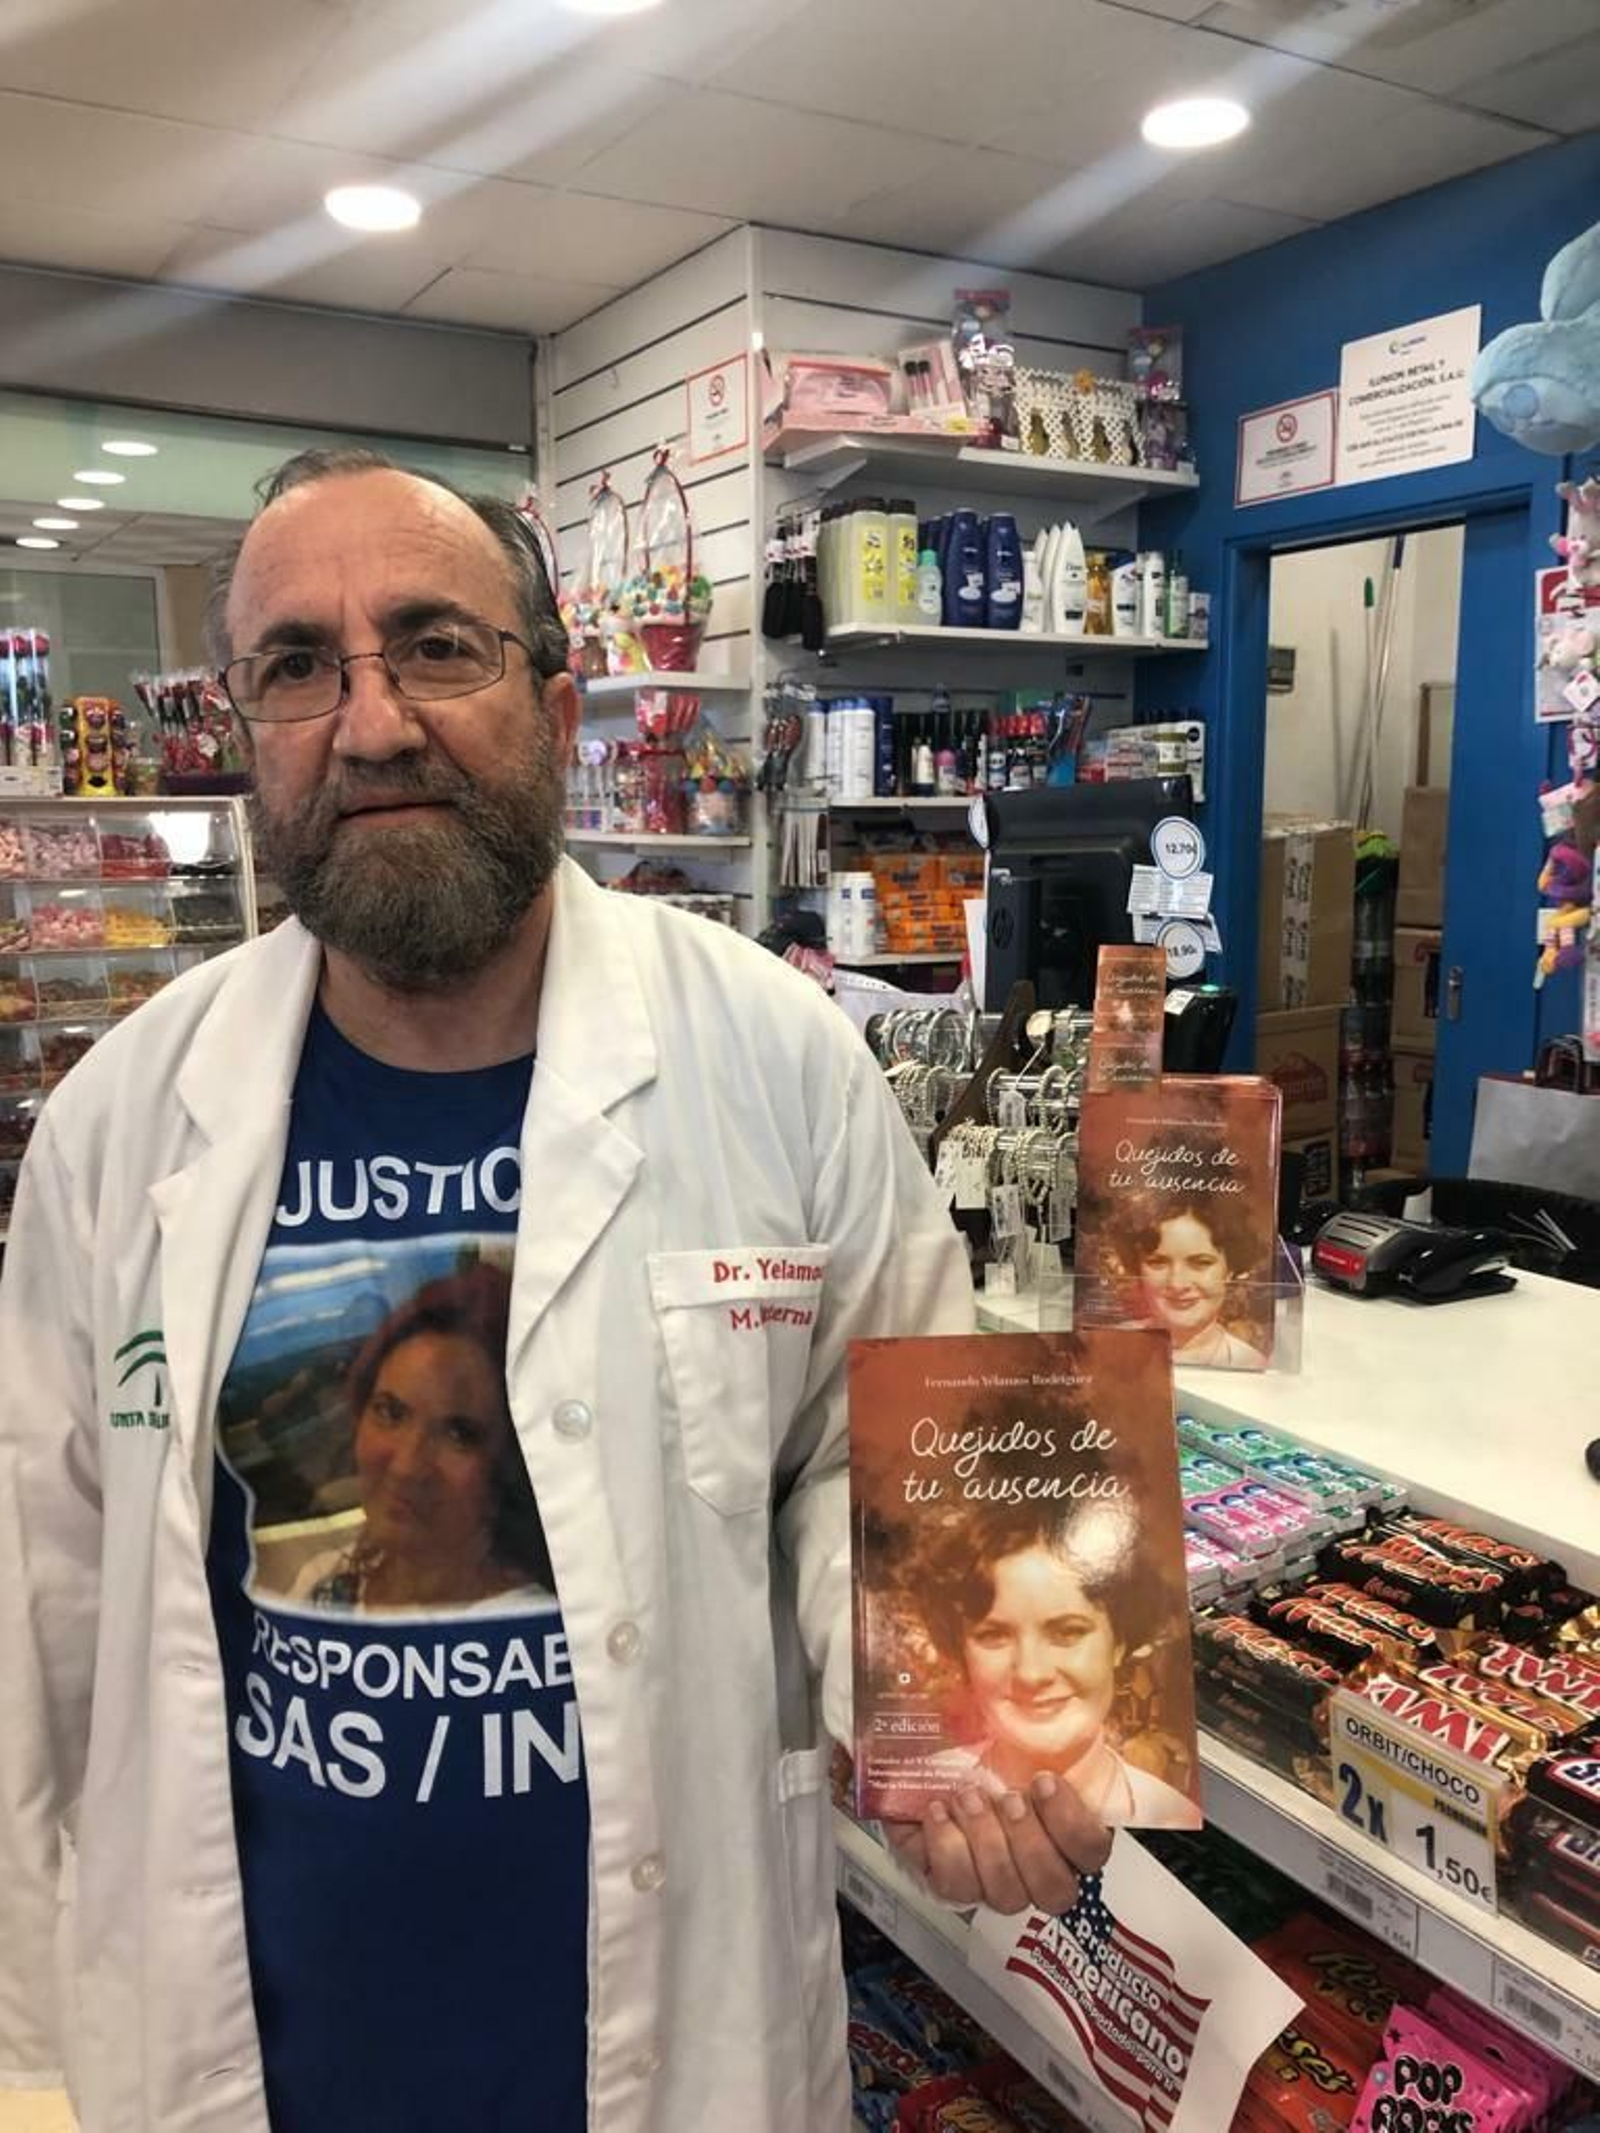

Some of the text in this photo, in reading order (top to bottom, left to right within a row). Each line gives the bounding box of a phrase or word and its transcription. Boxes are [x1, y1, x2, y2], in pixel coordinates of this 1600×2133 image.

[1108, 1170, 1246, 1194] tu ausencia
[1115, 1139, 1242, 1175] Quejidos de
[713, 1260, 751, 1283] Dr.
[911, 1417, 1118, 1478] Quejidos de
[902, 1470, 1131, 1505] tu ausencia
[234, 1671, 580, 1803] SAS / IN
[1346, 1717, 1480, 1805] ORBIT/CHOCO
[1076, 1917, 1161, 2011] Producto
[1037, 1917, 1187, 2074] Americano
[1393, 2053, 1464, 2106] POP
